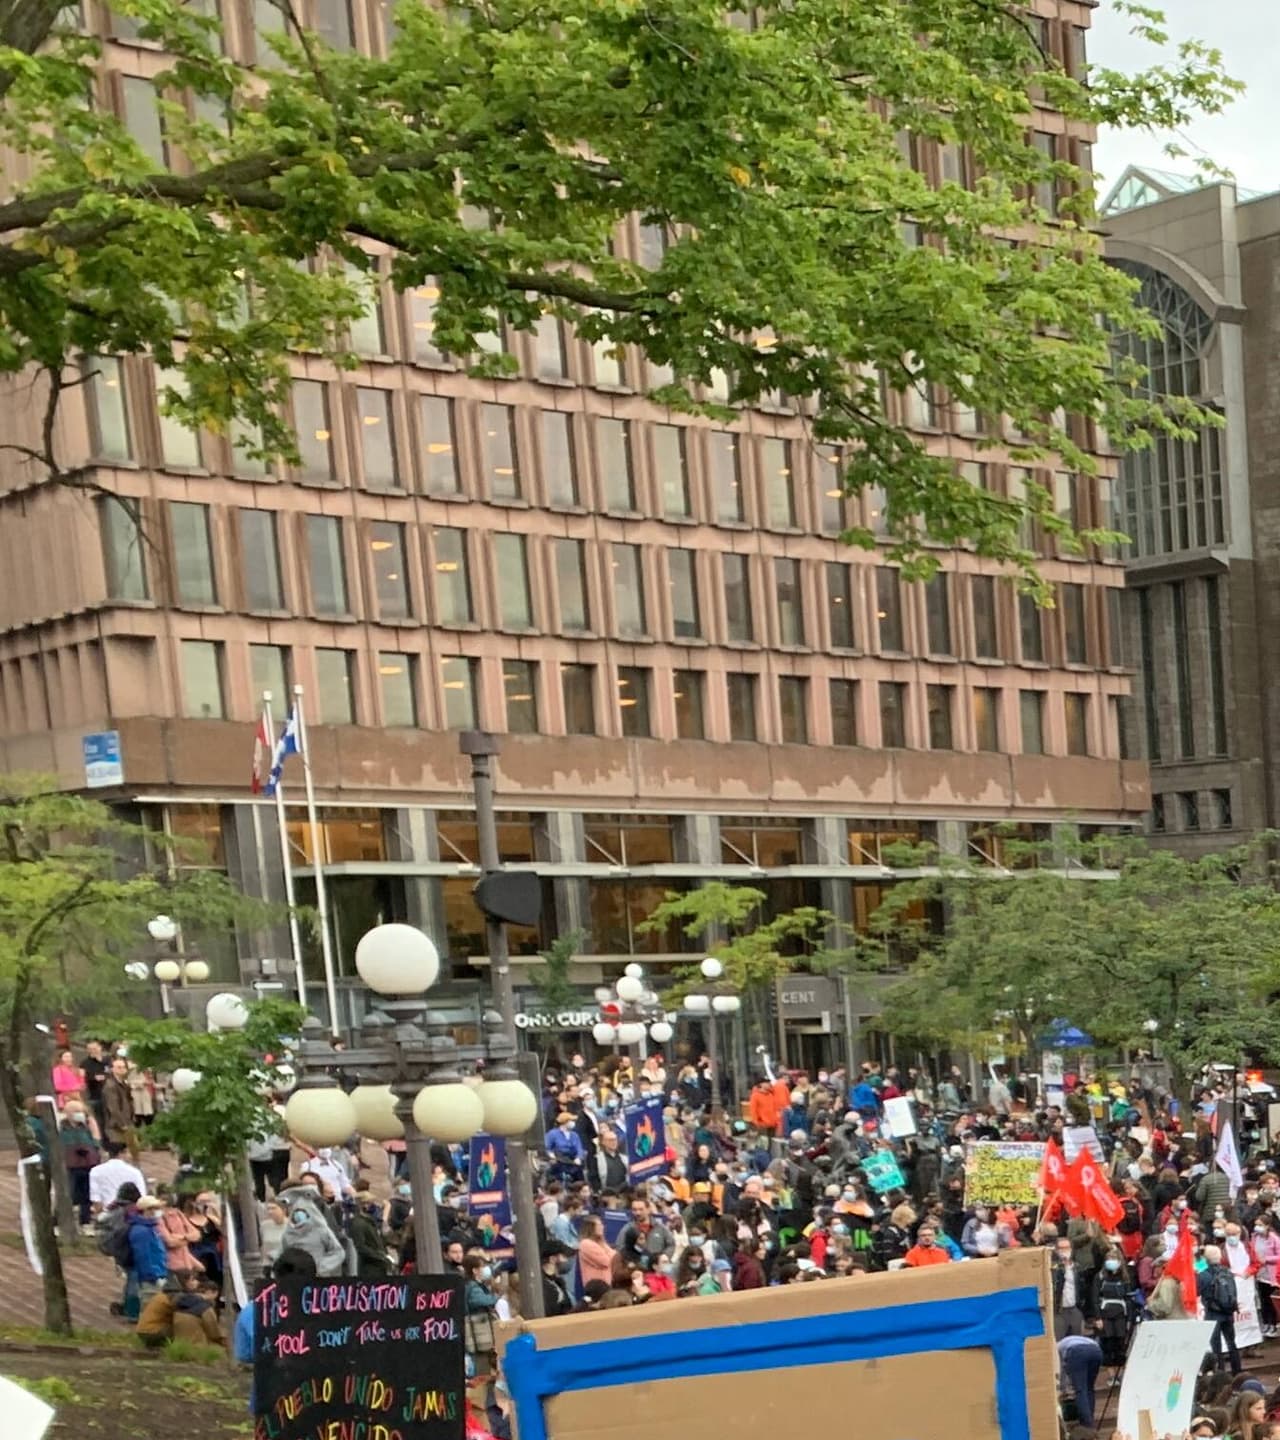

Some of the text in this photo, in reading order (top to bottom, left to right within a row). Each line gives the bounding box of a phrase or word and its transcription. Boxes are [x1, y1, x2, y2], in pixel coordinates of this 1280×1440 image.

[255, 1283, 289, 1327] The
[429, 1289, 454, 1311] NOT
[275, 1329, 311, 1358] TOOL
[423, 1317, 459, 1343] FOOL
[275, 1376, 333, 1429] PUEBLO
[402, 1386, 457, 1422] JAMAS
